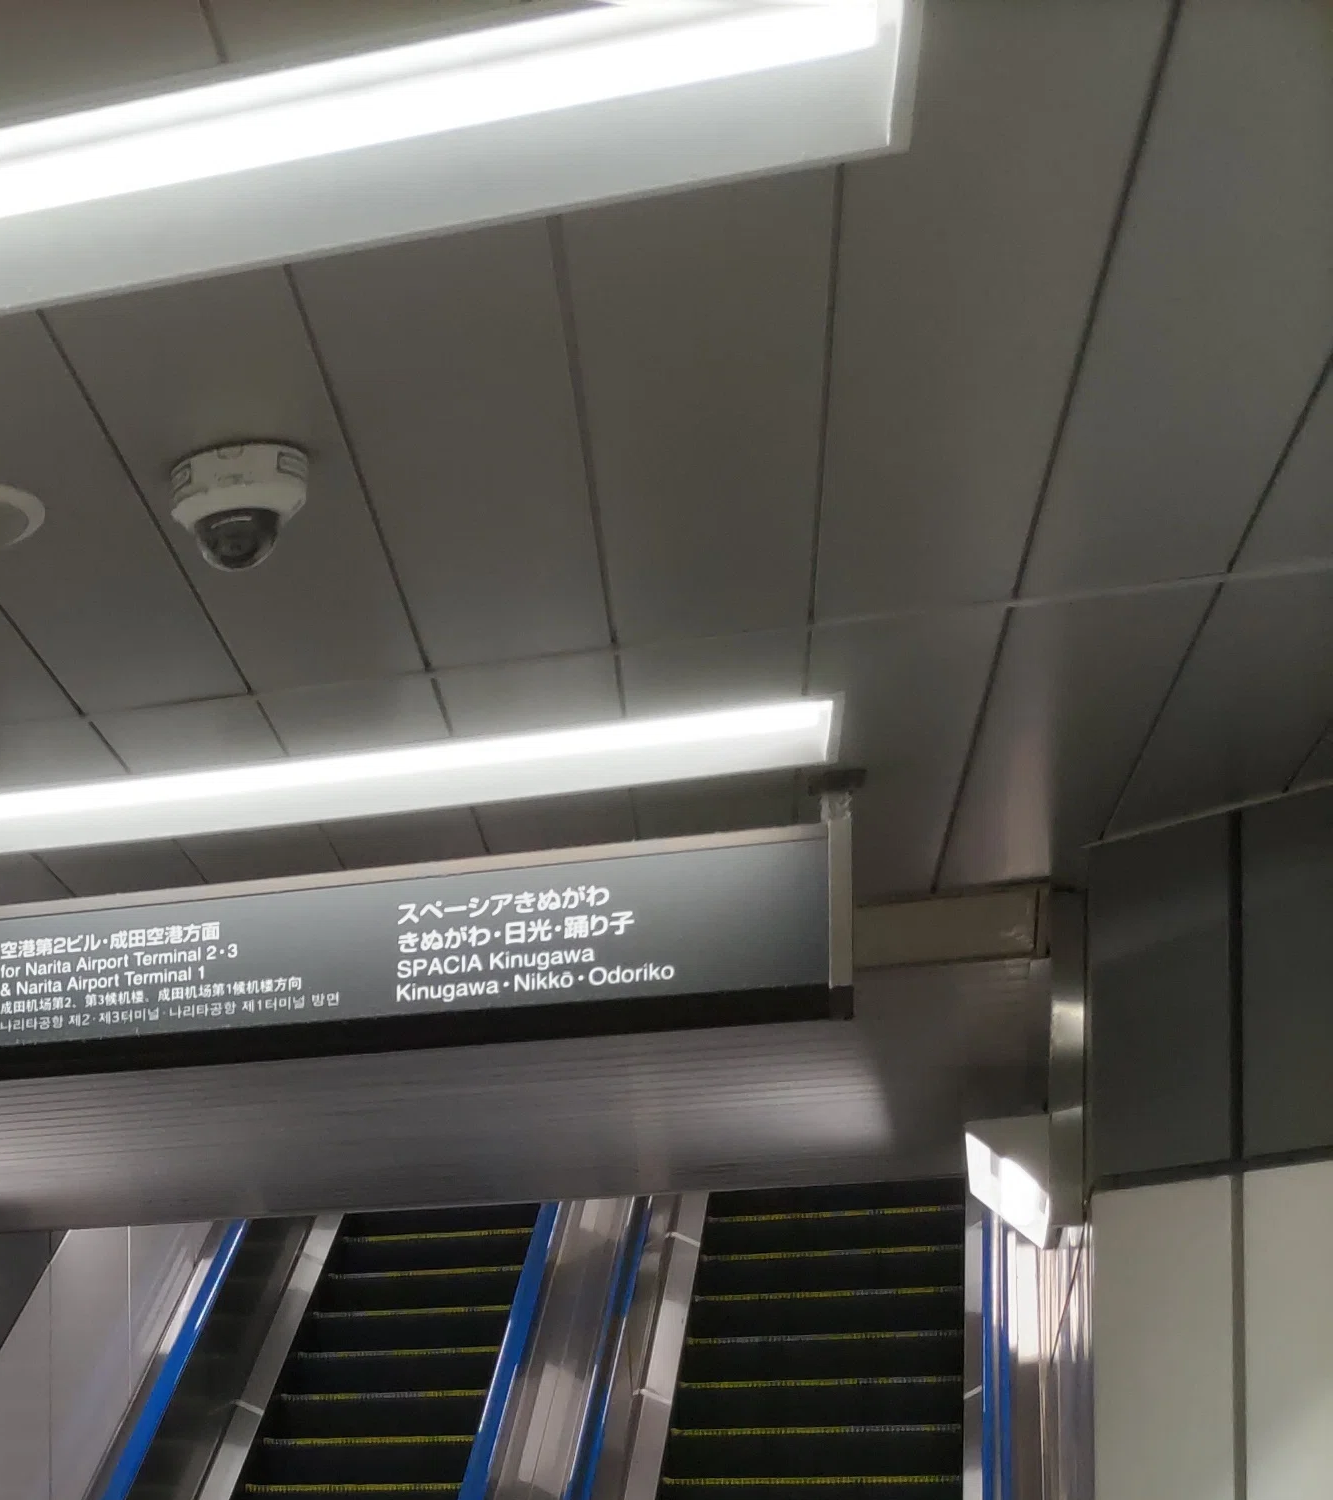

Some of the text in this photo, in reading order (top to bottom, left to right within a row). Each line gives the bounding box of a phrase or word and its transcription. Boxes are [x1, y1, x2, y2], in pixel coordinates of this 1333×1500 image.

[398, 886, 609, 924] スペーシアきぬがわ
[398, 911, 634, 953] きぬがわ・日光・踊り子
[1, 965, 21, 978] for
[26, 960, 71, 976] Narita
[76, 954, 128, 973] Airport
[133, 947, 201, 966] Terminal
[397, 948, 595, 978] SPACIA Kinugawa
[0, 966, 204, 997] & Narita Airport Terminal 1
[0, 1015, 63, 1032] 나리타공항
[242, 996, 305, 1013] 제1터미널
